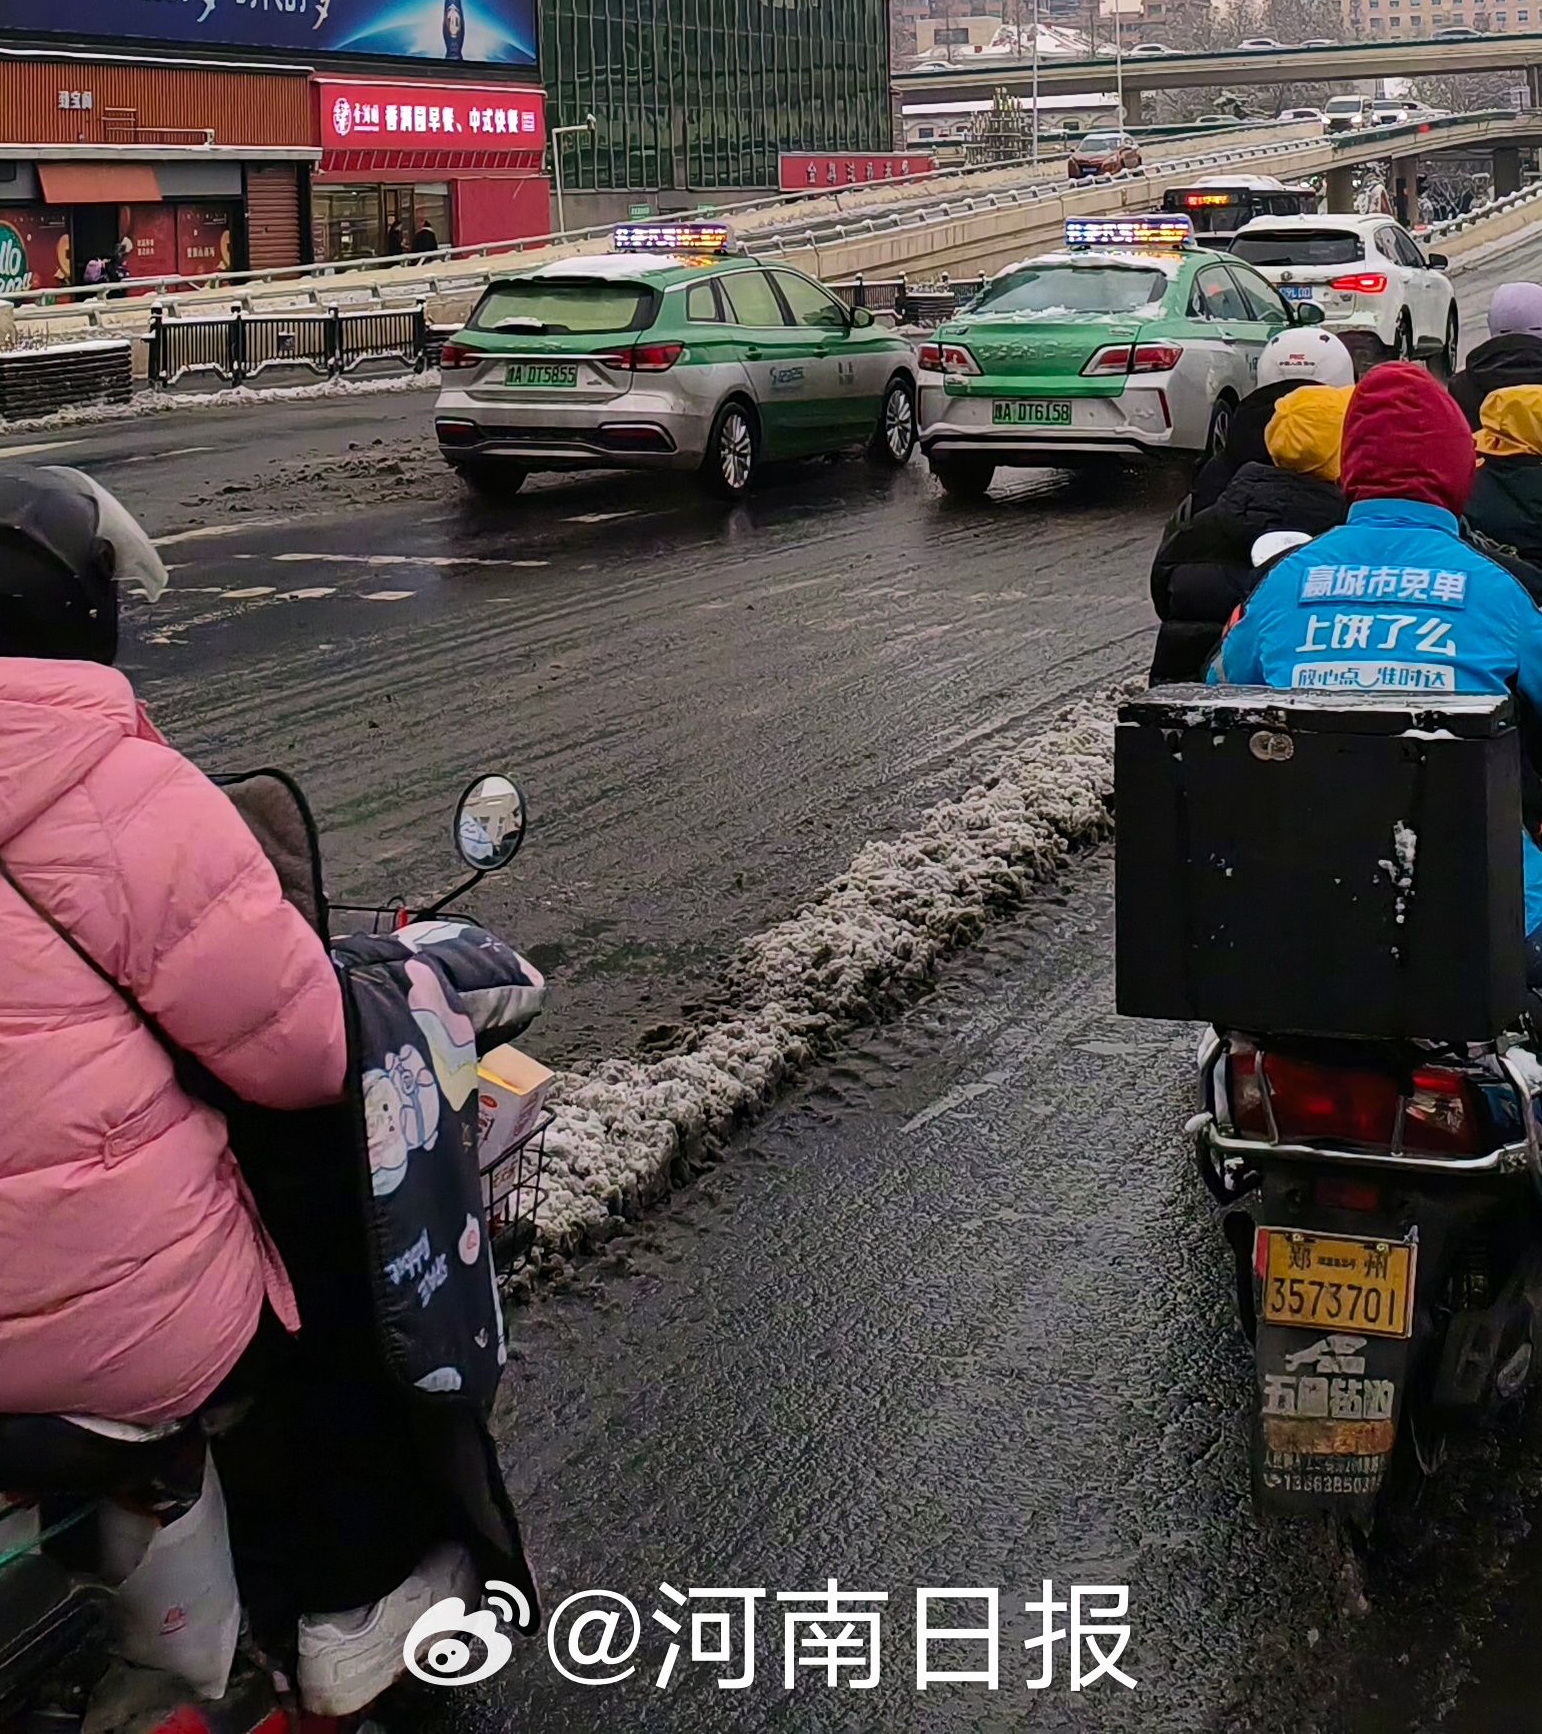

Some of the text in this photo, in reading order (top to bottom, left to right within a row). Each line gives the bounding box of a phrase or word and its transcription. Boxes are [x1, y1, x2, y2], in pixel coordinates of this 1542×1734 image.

[1017, 403, 1070, 421] DT6158
[1301, 564, 1467, 602] 赢城市免单
[1295, 613, 1457, 657] 上饿了么
[1271, 1277, 1395, 1326] 3573701
